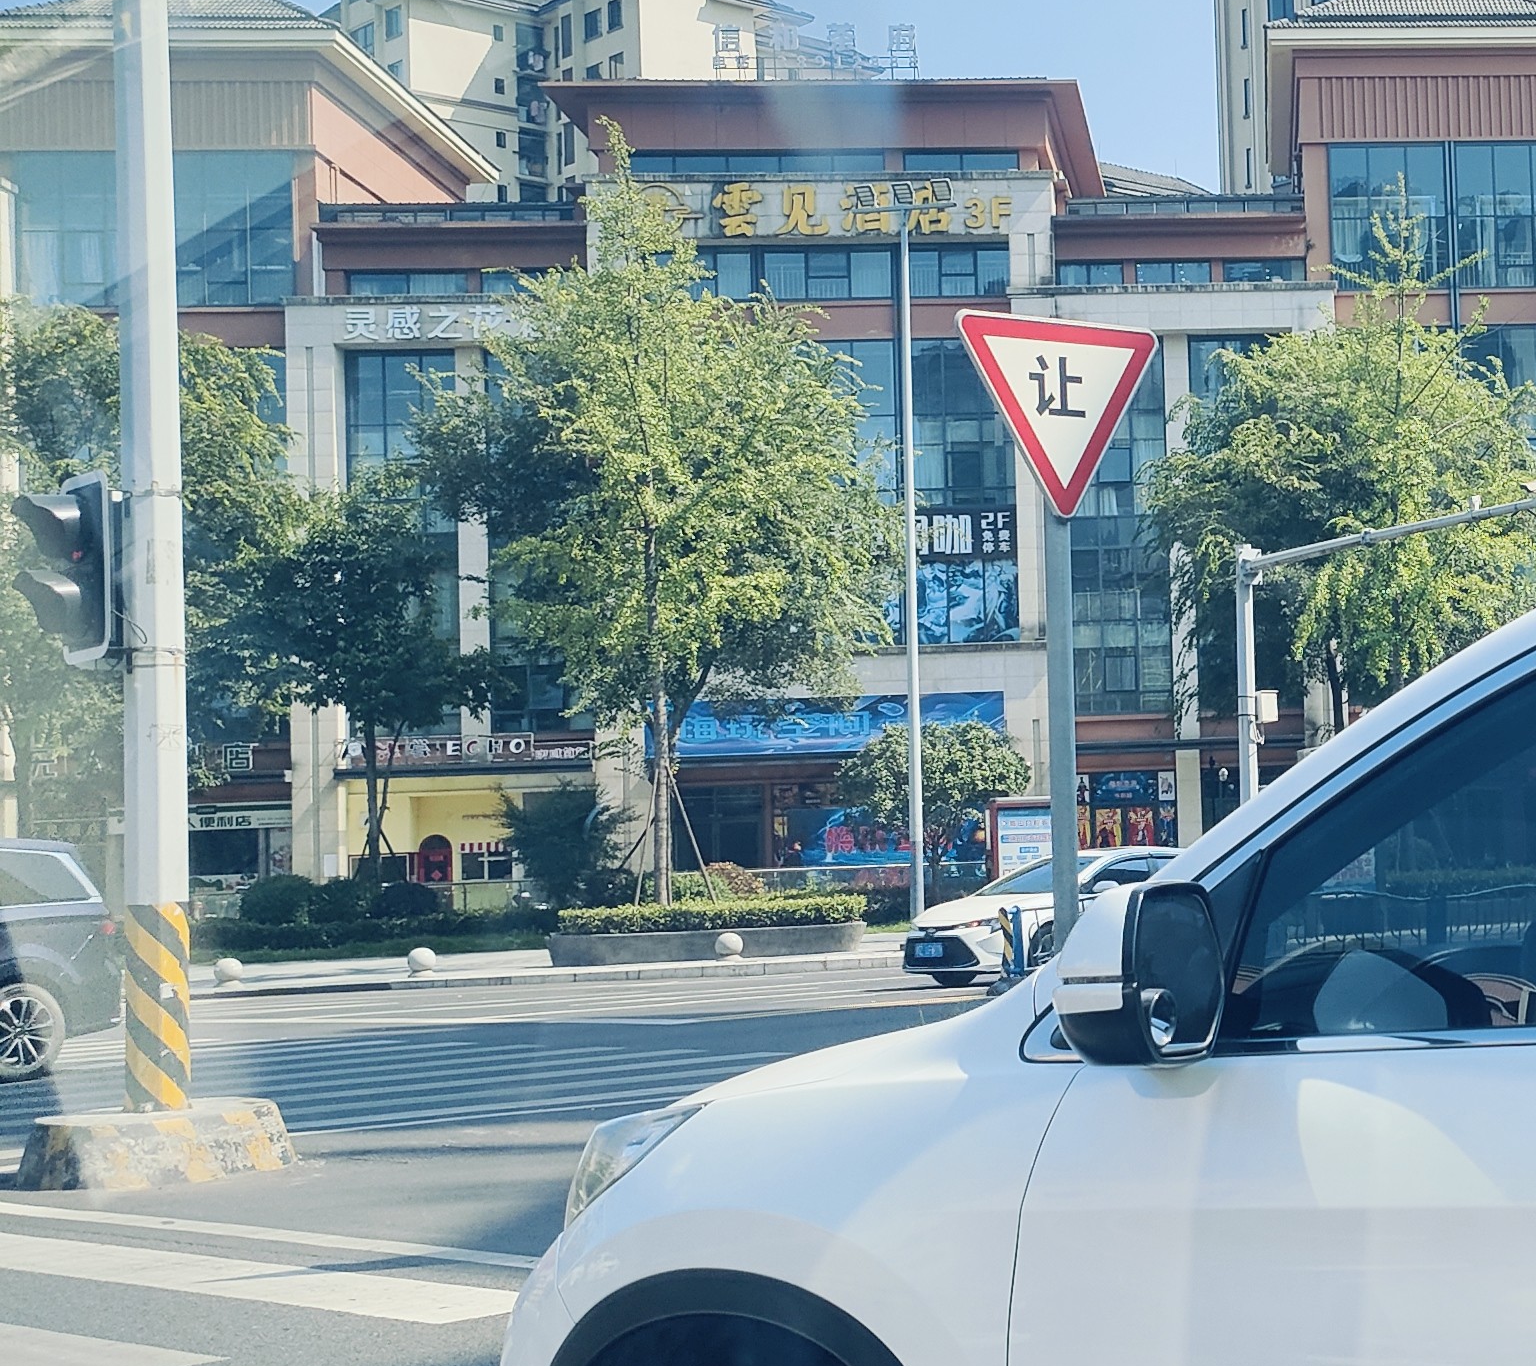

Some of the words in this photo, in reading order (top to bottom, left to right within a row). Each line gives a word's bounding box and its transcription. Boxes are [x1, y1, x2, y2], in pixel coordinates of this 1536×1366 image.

[964, 197, 1012, 229] 3F
[1028, 355, 1086, 418] 让
[980, 512, 1011, 529] 2F
[446, 738, 526, 756] ECHO
